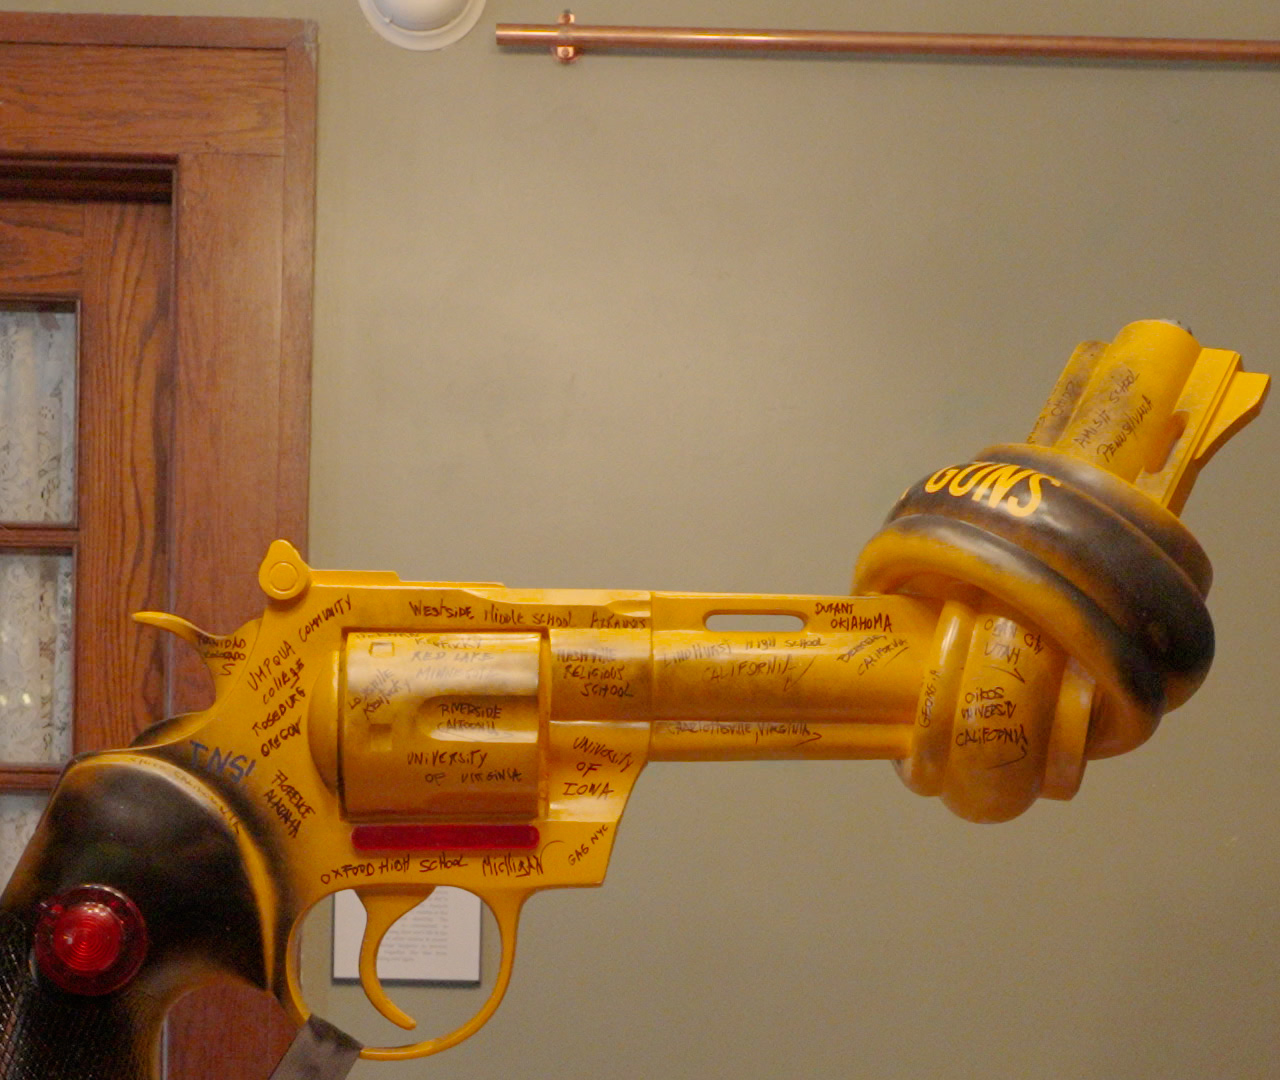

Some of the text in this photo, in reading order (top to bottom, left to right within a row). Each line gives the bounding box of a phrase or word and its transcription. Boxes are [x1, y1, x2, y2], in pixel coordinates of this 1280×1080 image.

[924, 461, 1062, 518] GUNS
[576, 761, 603, 778] OF
[424, 771, 447, 787] OF
[562, 781, 615, 800] IOWA
